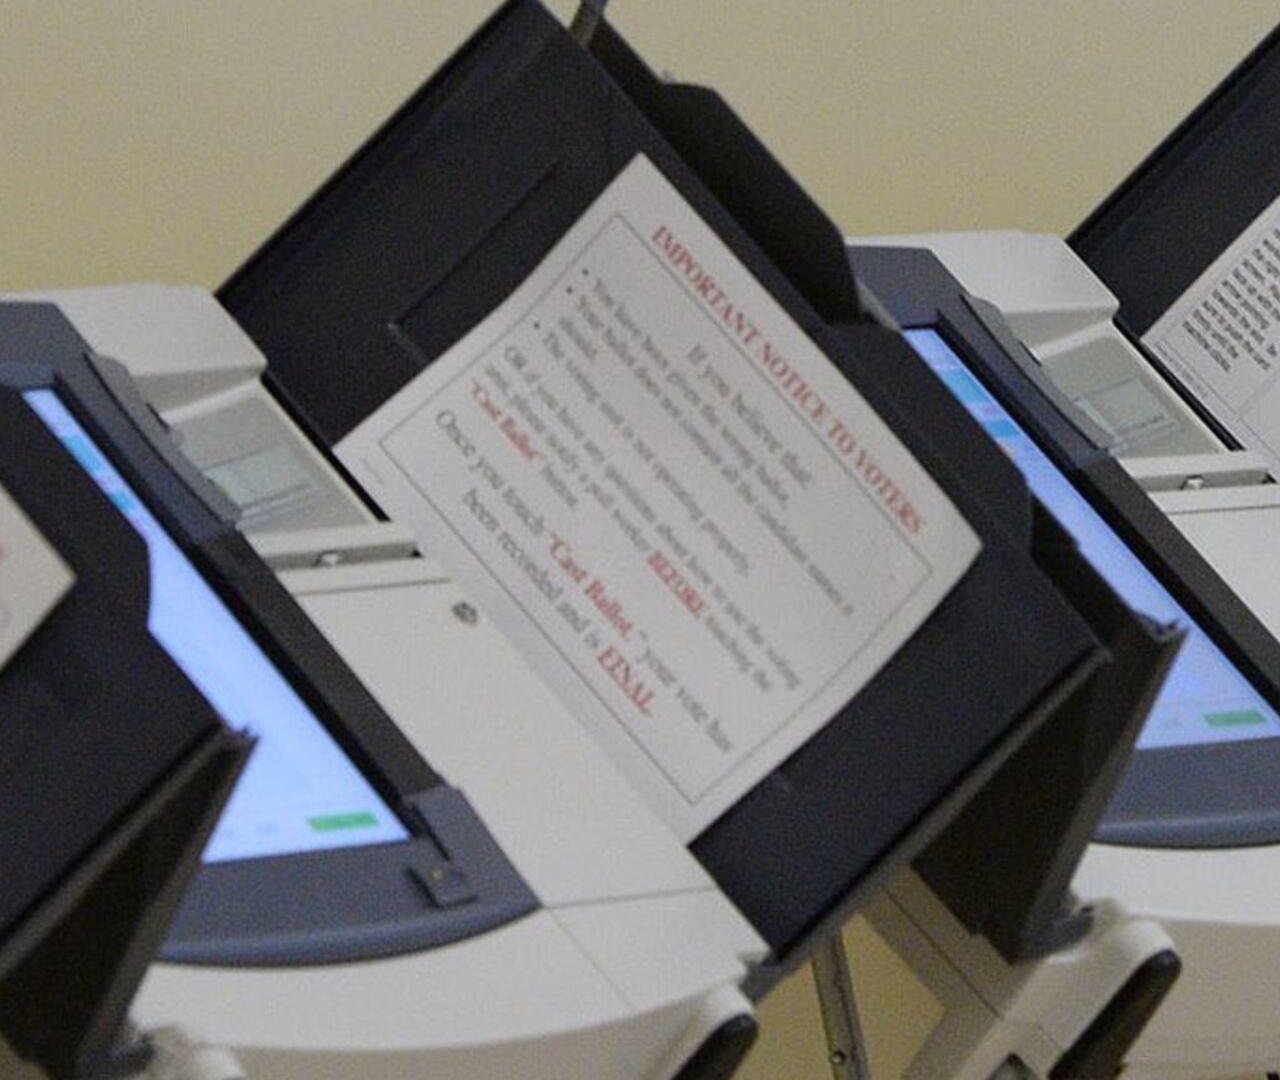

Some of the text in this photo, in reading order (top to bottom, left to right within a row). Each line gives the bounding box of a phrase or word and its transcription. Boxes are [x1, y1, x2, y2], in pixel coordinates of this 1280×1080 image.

[653, 225, 926, 535] IMPORTANT NOTICE TO VOTERS
